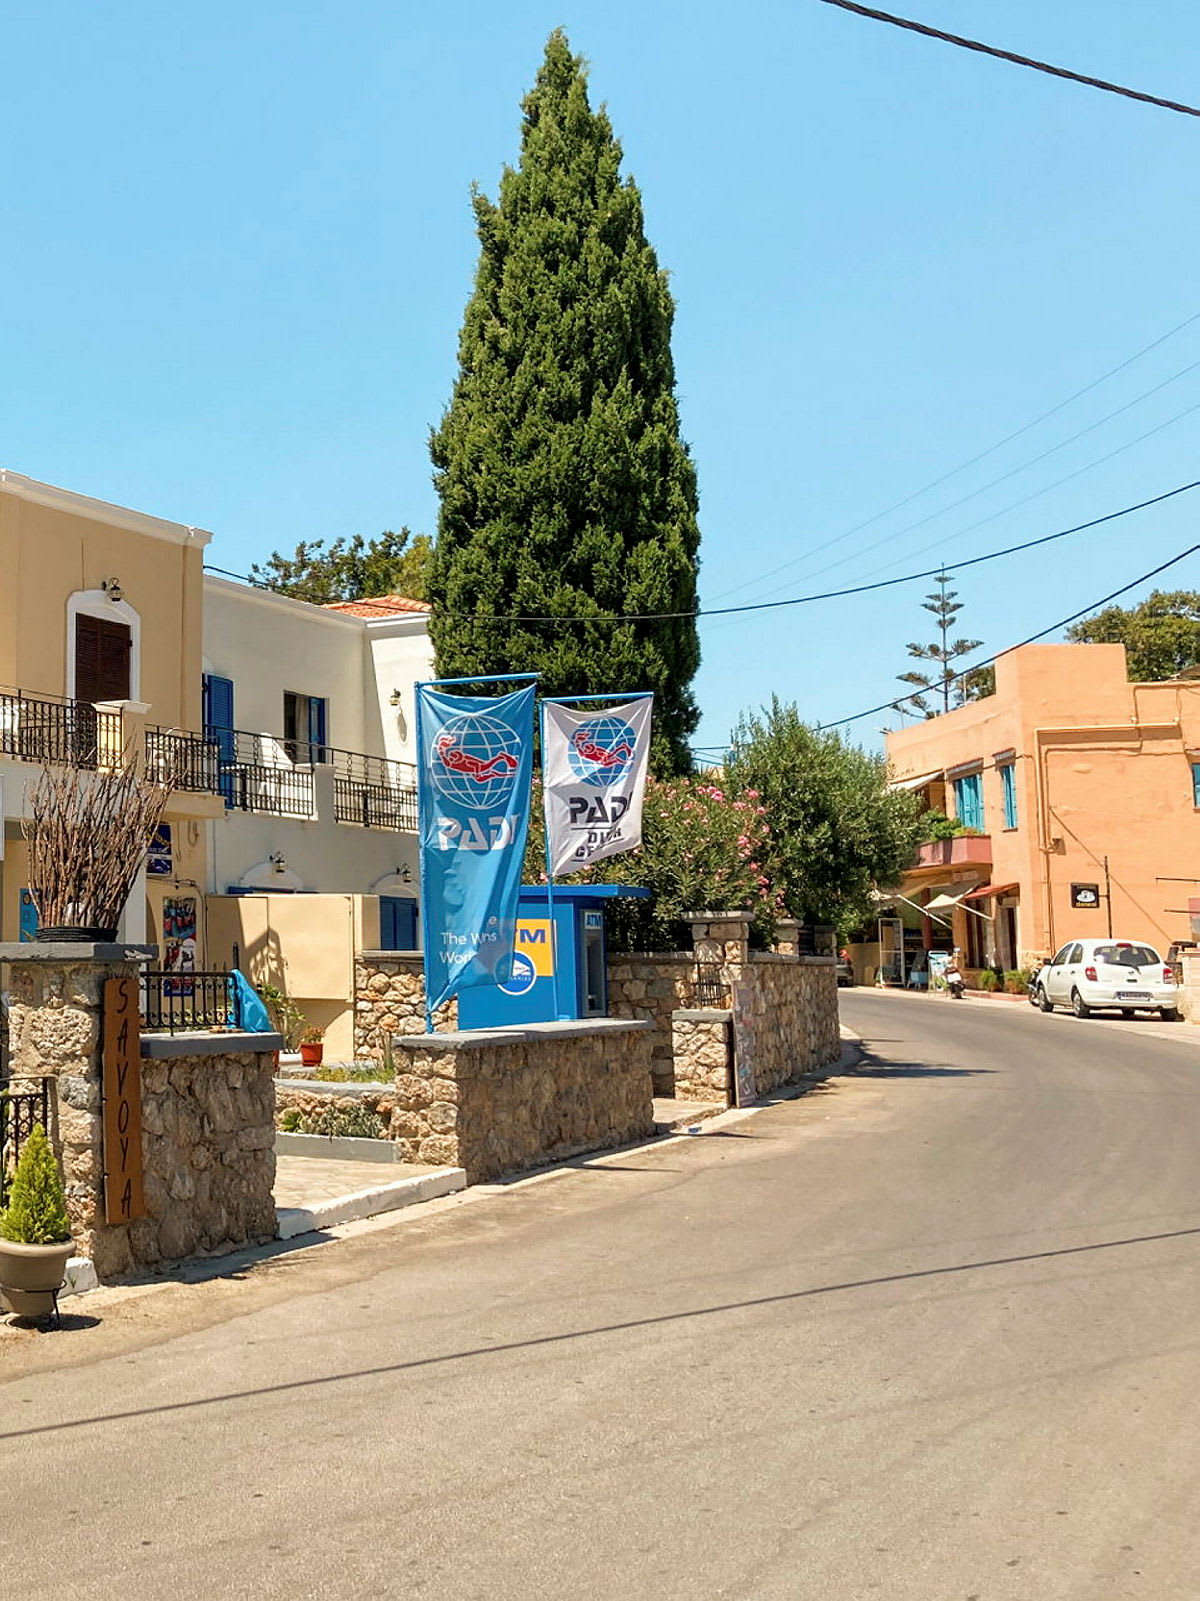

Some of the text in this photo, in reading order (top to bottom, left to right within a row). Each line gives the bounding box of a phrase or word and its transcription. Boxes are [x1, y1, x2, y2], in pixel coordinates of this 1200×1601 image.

[437, 813, 520, 850] PADI
[440, 932, 467, 945] The
[116, 979, 132, 1219] SAVOYA
